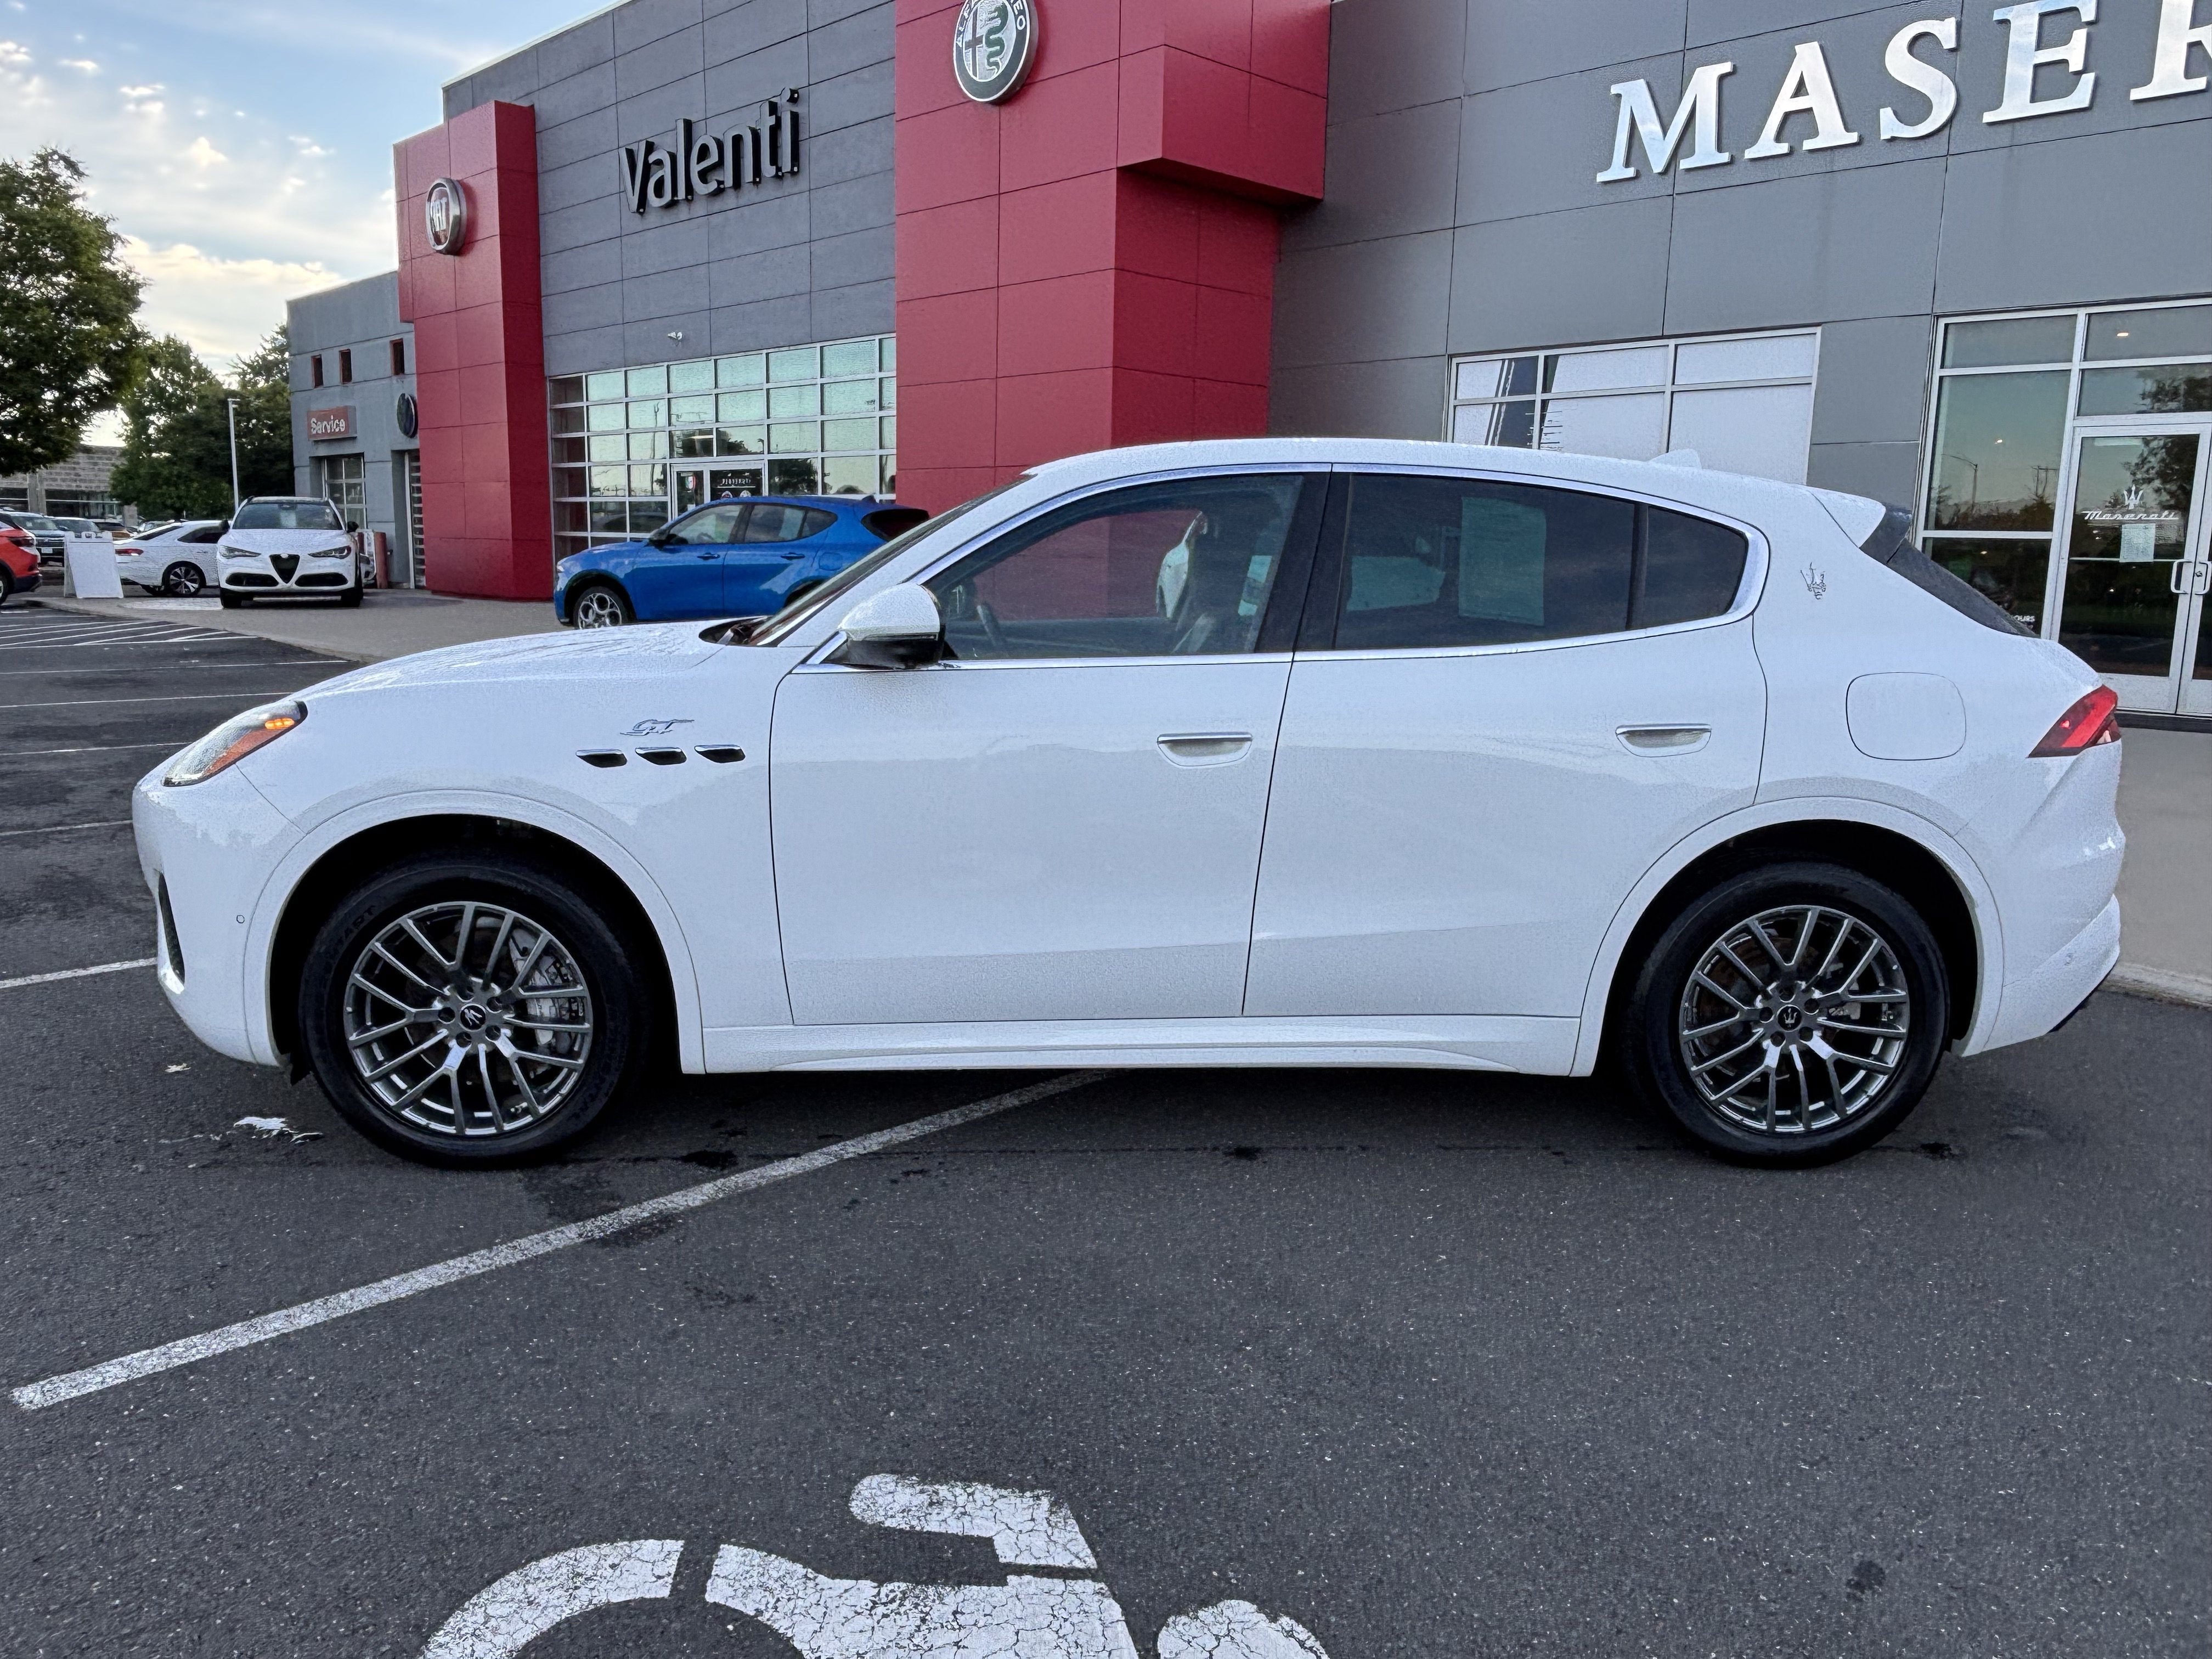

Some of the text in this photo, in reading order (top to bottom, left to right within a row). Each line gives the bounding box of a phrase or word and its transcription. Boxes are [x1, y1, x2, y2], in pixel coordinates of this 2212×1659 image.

[619, 87, 799, 213] Valenti
[311, 415, 345, 435] Service
[2081, 510, 2179, 520] Maserati
